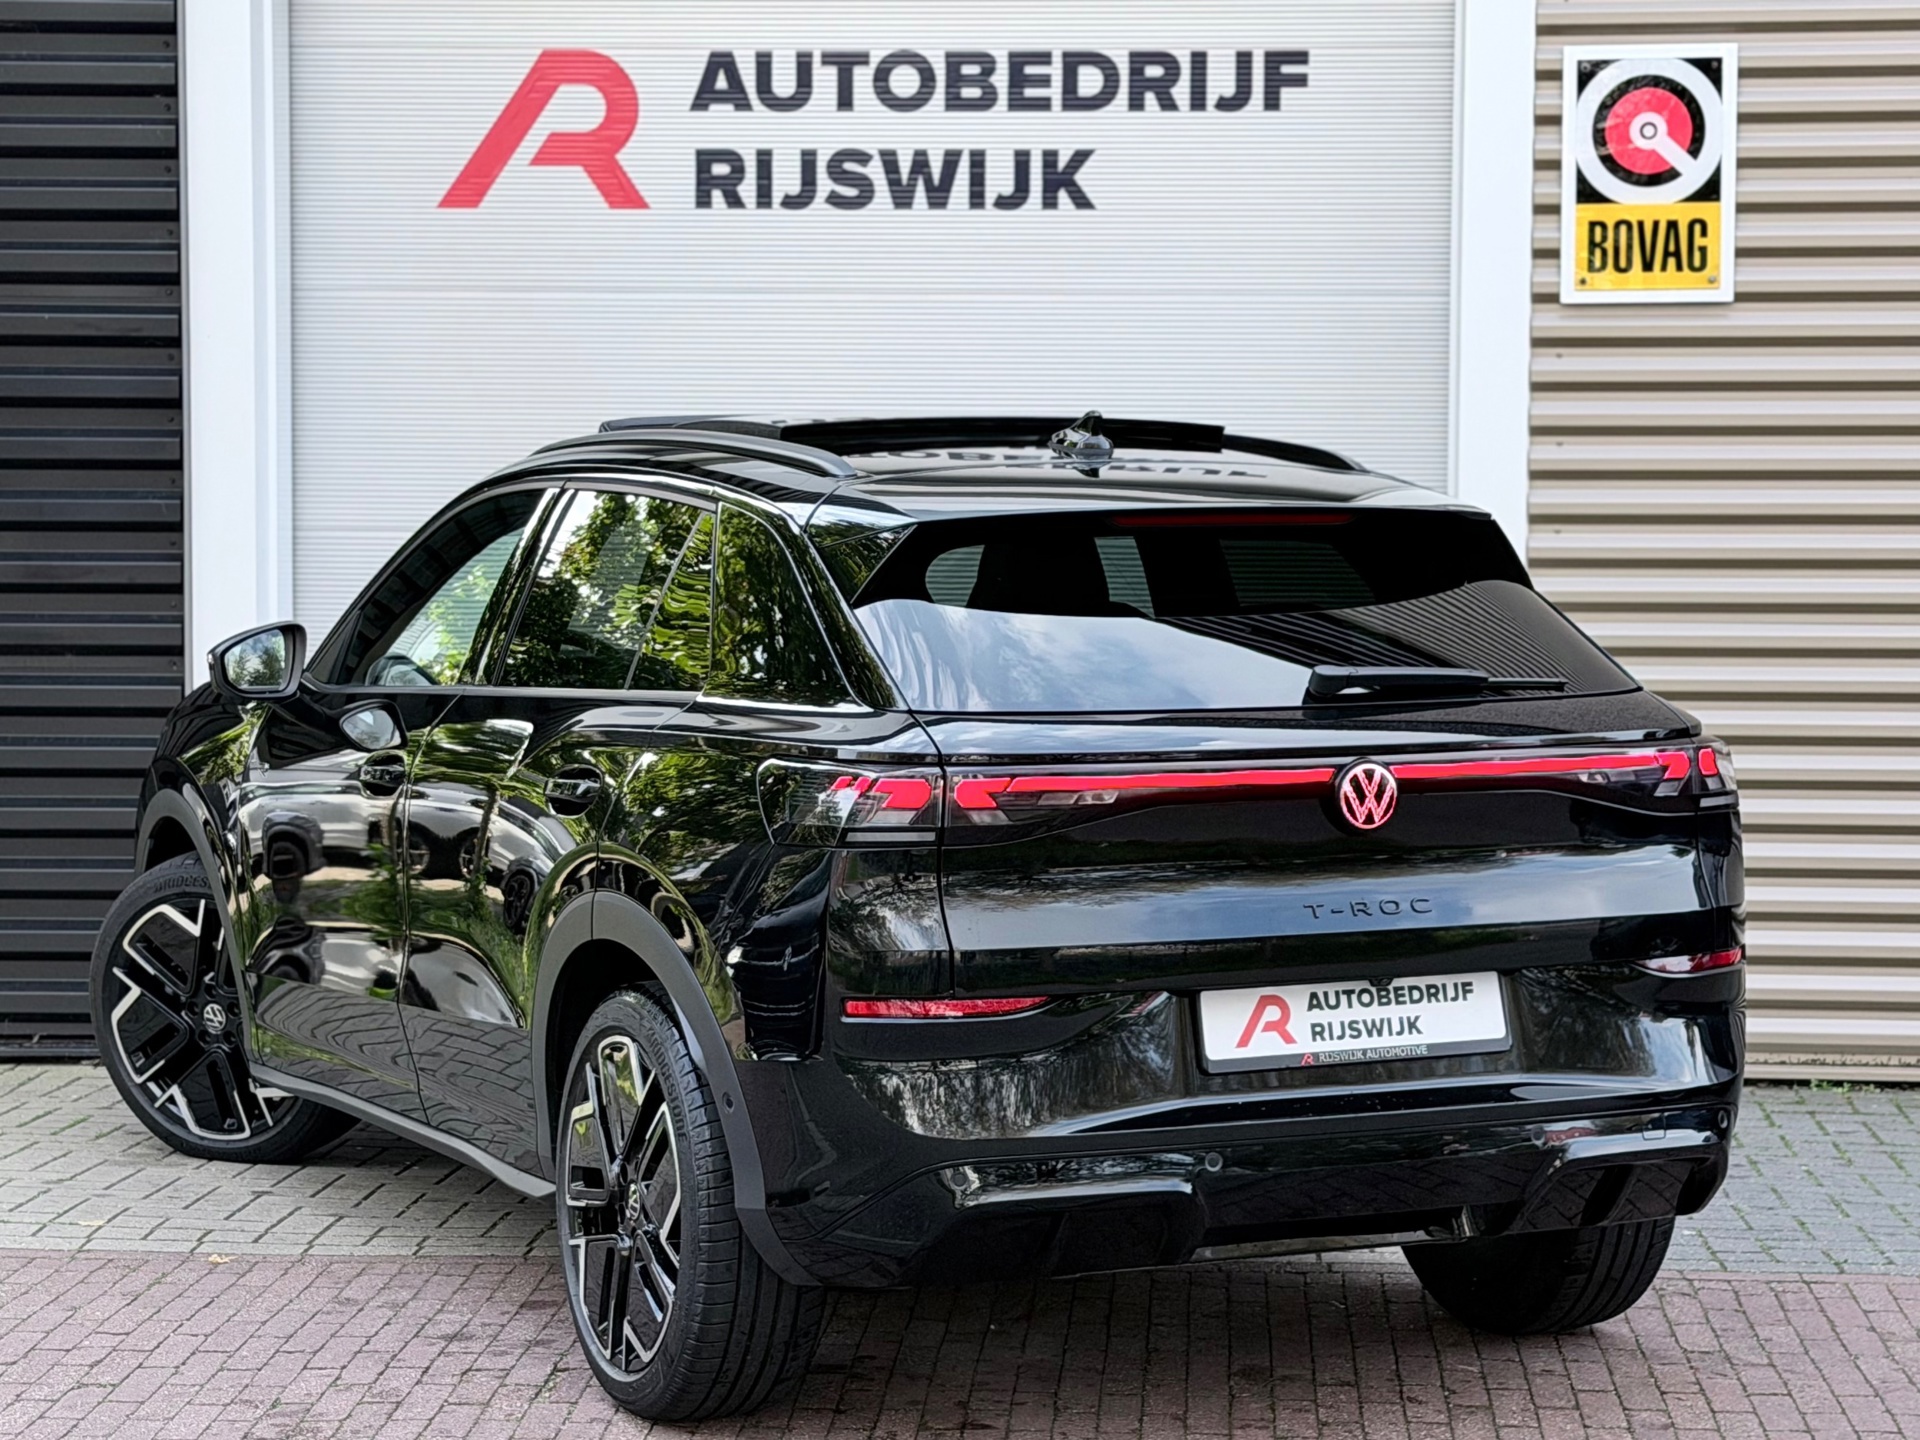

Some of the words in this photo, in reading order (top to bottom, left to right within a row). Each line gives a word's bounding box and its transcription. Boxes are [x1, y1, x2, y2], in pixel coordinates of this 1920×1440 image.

[690, 50, 1310, 112] AUTOBEDRIJF
[695, 148, 1096, 211] RIJSWIJK
[1587, 217, 1709, 275] BOVAG
[152, 873, 211, 894] BRIDGES
[1302, 897, 1433, 920] T-ROC
[1306, 980, 1475, 1012] AUTOBEDRIJF
[1309, 1014, 1424, 1043] RIJSWIJK
[1318, 1049, 1365, 1063] RIJSWIJK
[1366, 1044, 1428, 1060] AUTOMOTIVE
